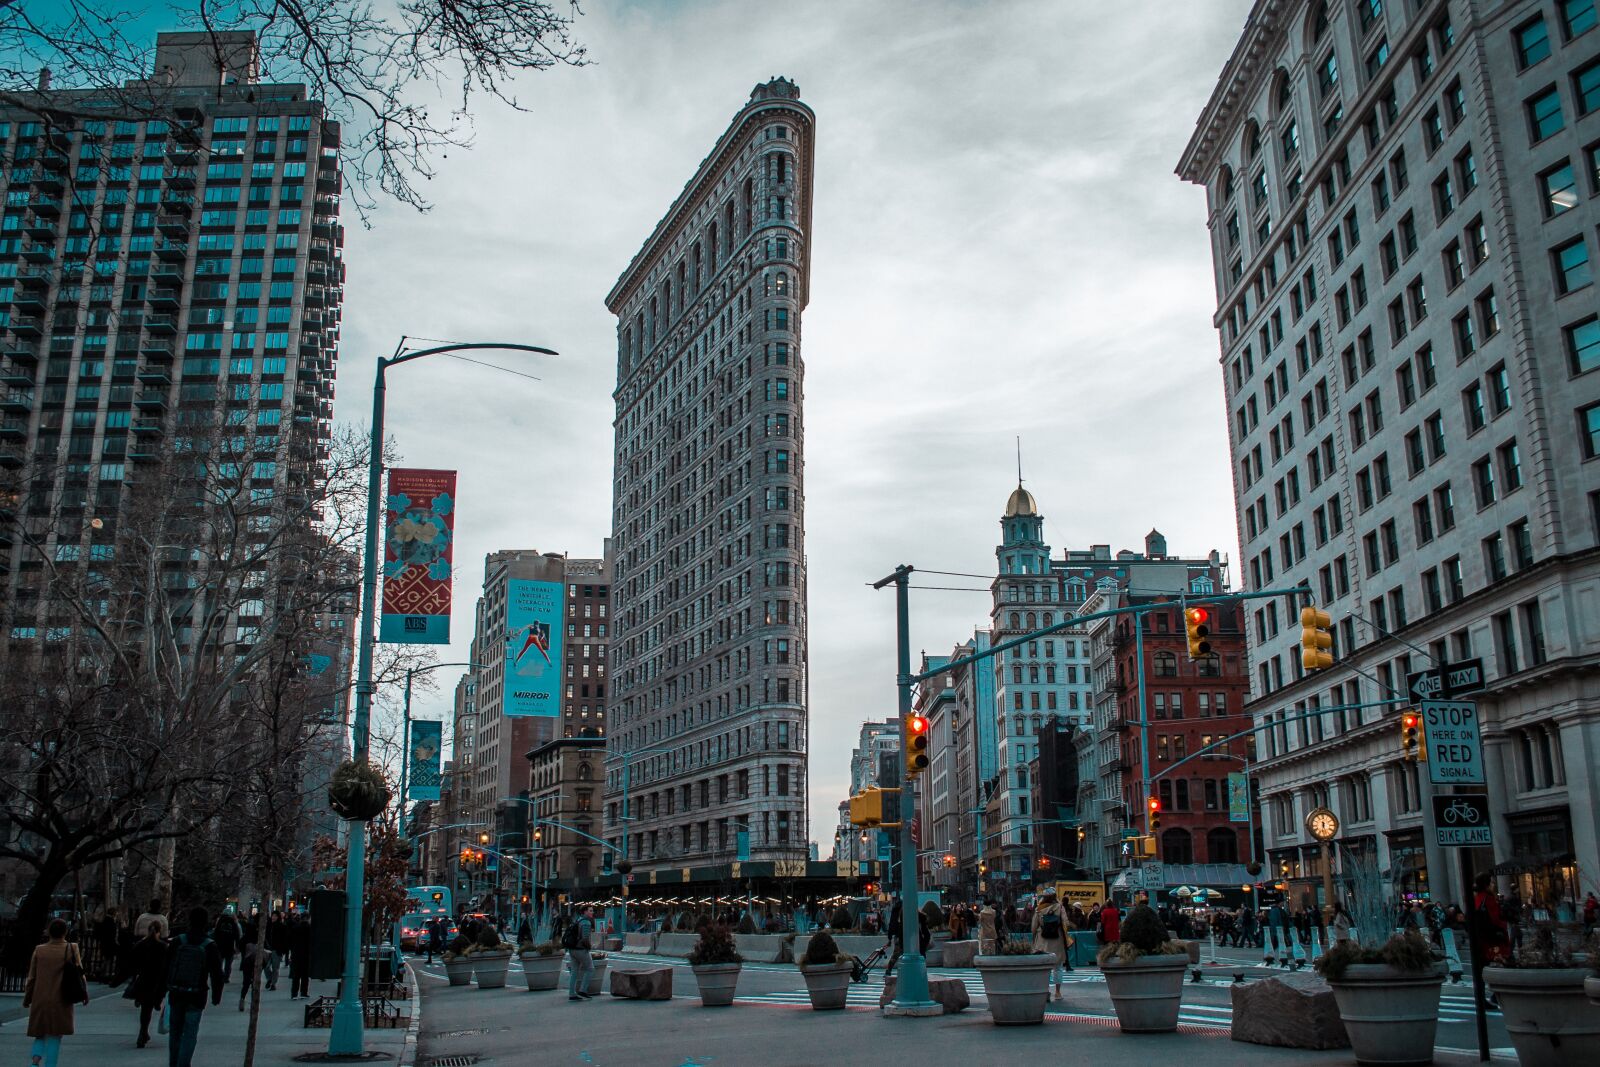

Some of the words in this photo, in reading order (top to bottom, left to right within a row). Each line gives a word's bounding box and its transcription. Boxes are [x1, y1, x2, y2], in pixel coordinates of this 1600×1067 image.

[384, 567, 422, 598] MAD.
[398, 590, 425, 611] SQ.
[423, 592, 450, 614] PK.
[405, 617, 427, 629] ABS
[1418, 677, 1441, 693] ONE
[1448, 669, 1473, 686] WAY
[513, 691, 550, 700] MIRROR
[1427, 707, 1473, 726] STOP
[1432, 730, 1456, 740] HERE
[1460, 730, 1473, 740] ON
[1437, 744, 1472, 763] RED
[1440, 767, 1475, 778] SIGNAL
[1439, 829, 1460, 842] BIKE
[1463, 829, 1489, 842] LANE
